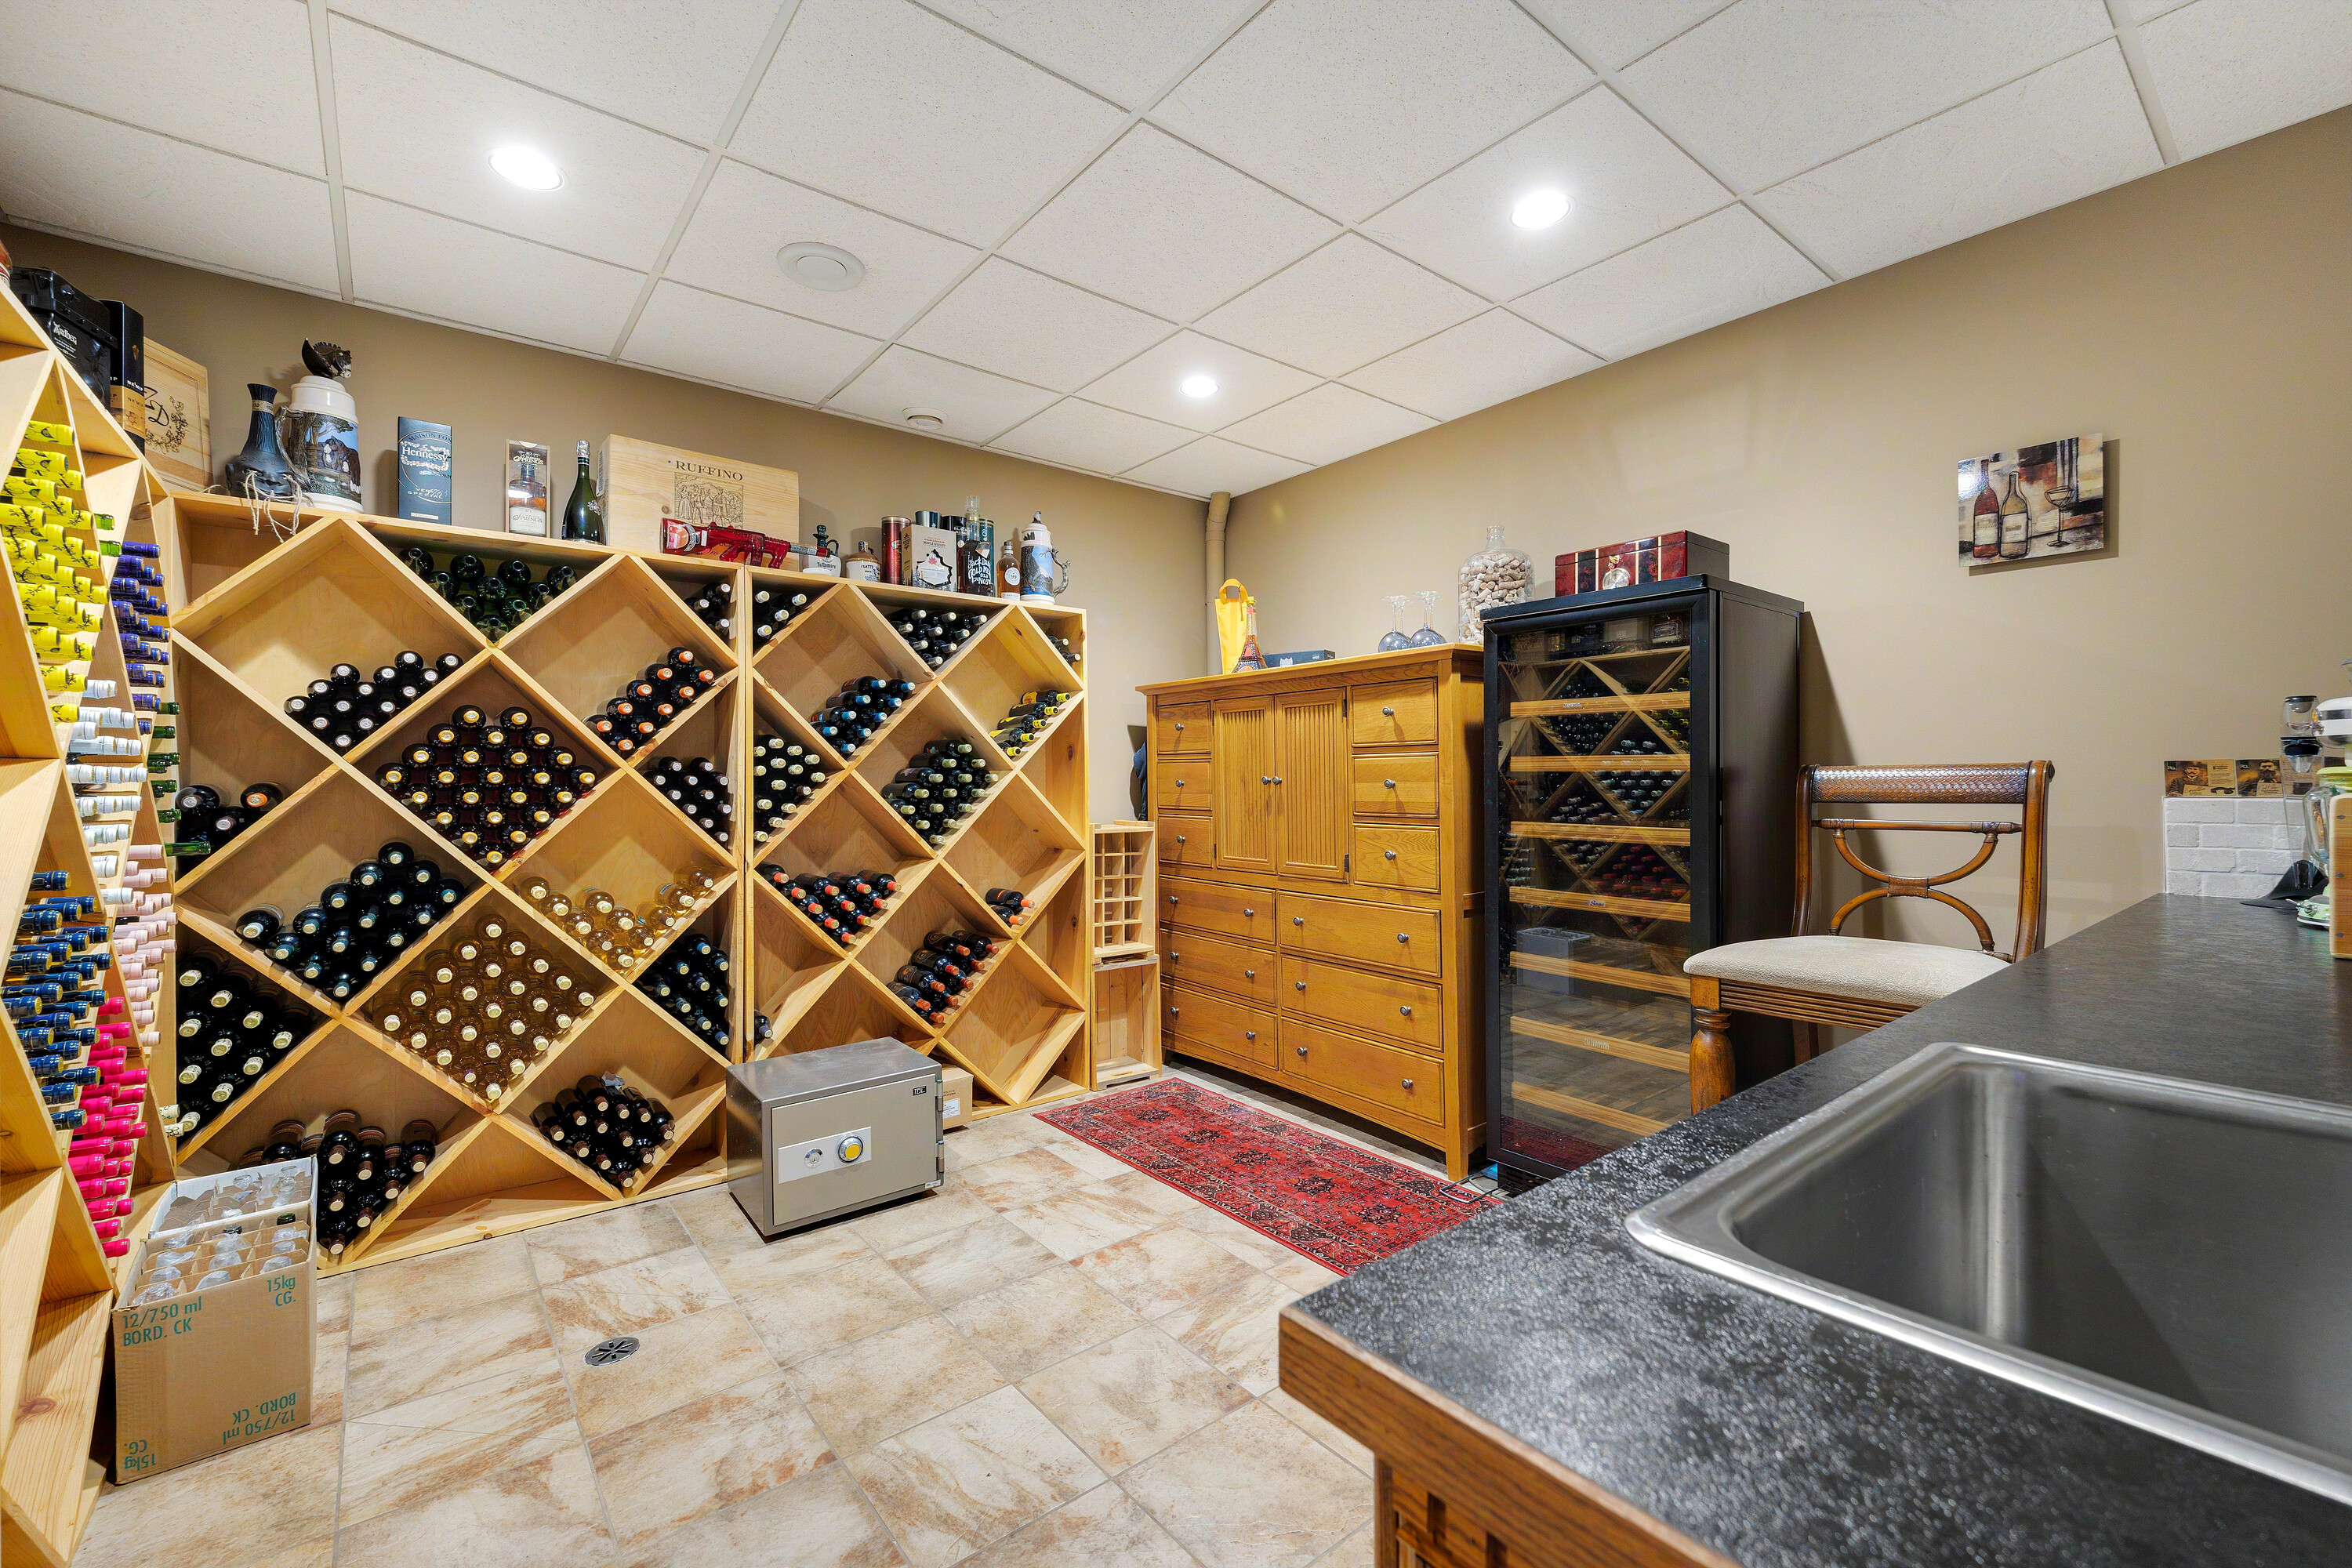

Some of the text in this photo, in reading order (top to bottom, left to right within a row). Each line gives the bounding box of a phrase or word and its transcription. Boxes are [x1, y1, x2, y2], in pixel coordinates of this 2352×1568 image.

[408, 432, 436, 442] MAISON
[402, 446, 448, 463] Hennessy
[675, 460, 743, 481] RUFFINO
[512, 514, 543, 523] SPRINGS
[267, 1276, 296, 1292] 15kg
[275, 1291, 296, 1307] CG.
[122, 1295, 202, 1329] 12/750 ml
[123, 1317, 193, 1347] BORD. CK
[233, 1392, 296, 1425] BORD. CK
[223, 1409, 296, 1445] 12/750 ml
[124, 1439, 147, 1455] CG.
[124, 1453, 157, 1472] 15kg
